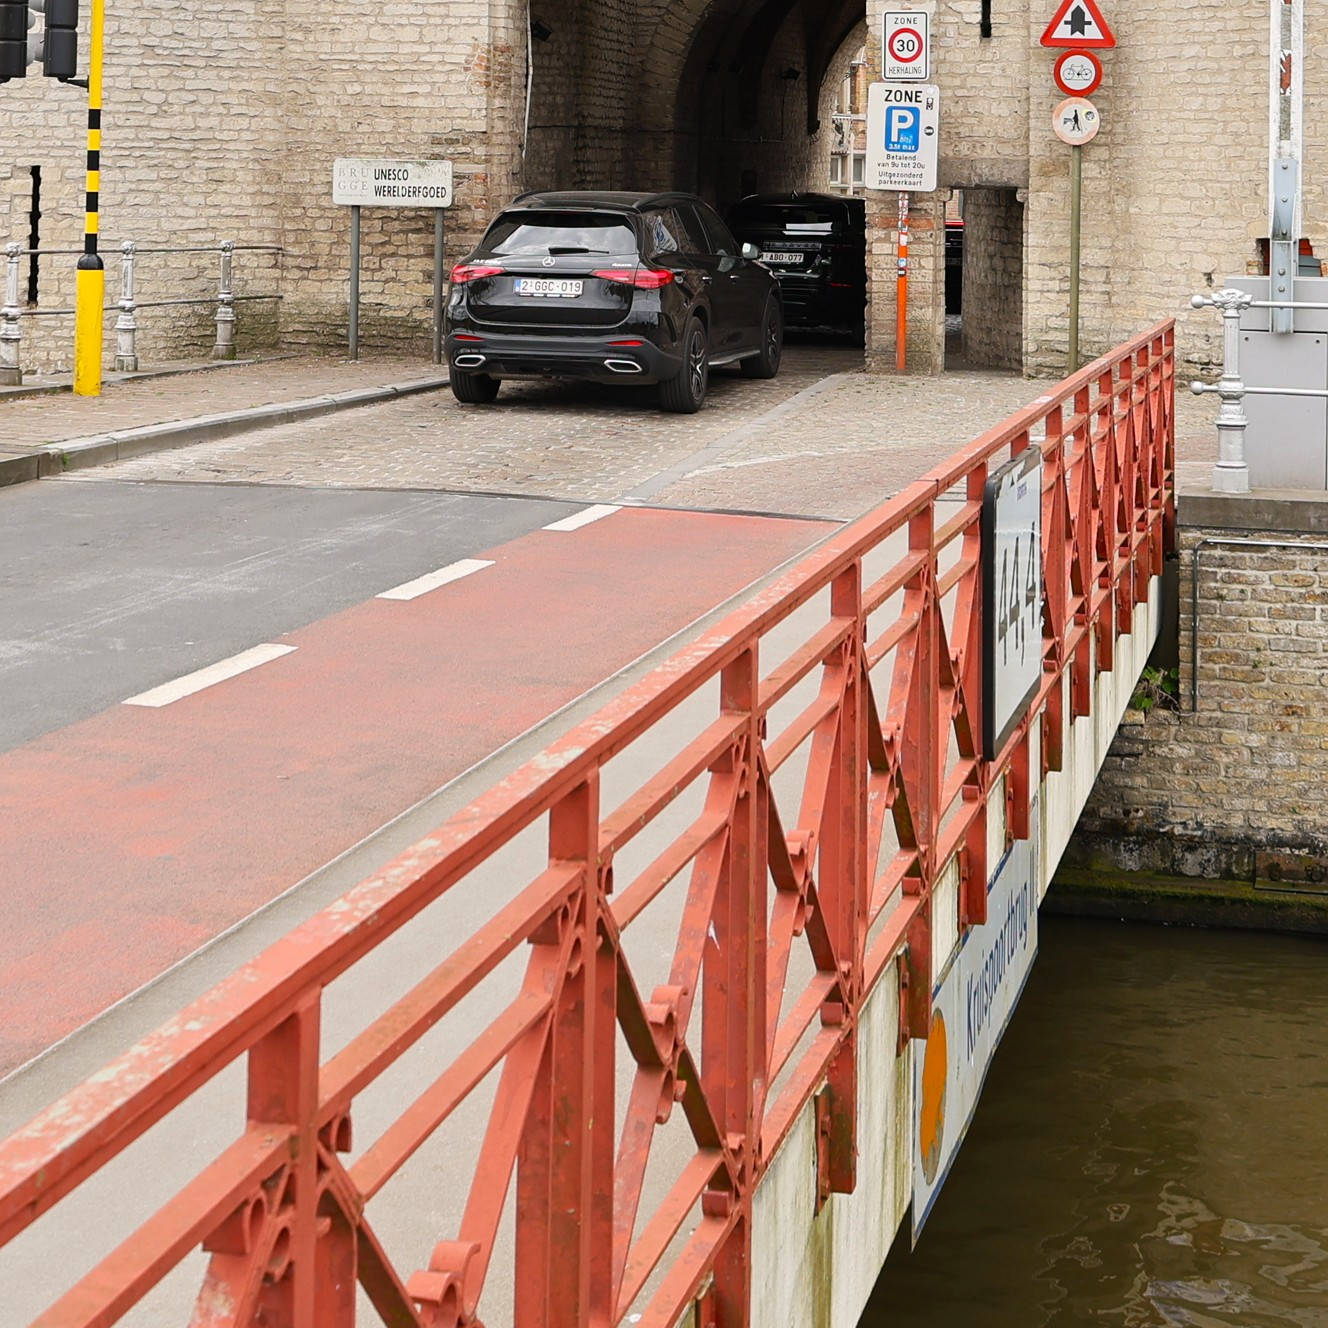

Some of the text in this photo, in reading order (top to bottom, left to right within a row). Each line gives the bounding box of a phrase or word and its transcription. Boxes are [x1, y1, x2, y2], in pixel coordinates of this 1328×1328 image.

[896, 39, 915, 52] 30
[888, 66, 922, 75] HERHALING
[884, 89, 923, 103] ZONE
[891, 109, 914, 142] P
[338, 167, 369, 178] BRU
[374, 168, 409, 181] UNESCO
[878, 171, 923, 180] Uitgezonderd
[338, 181, 369, 191] GGE
[878, 179, 922, 187] parkeerkaart
[374, 185, 447, 198] WERELDERFGOED
[998, 521, 1036, 666] 44,4
[966, 878, 1029, 1065] Kruispoortbrug
